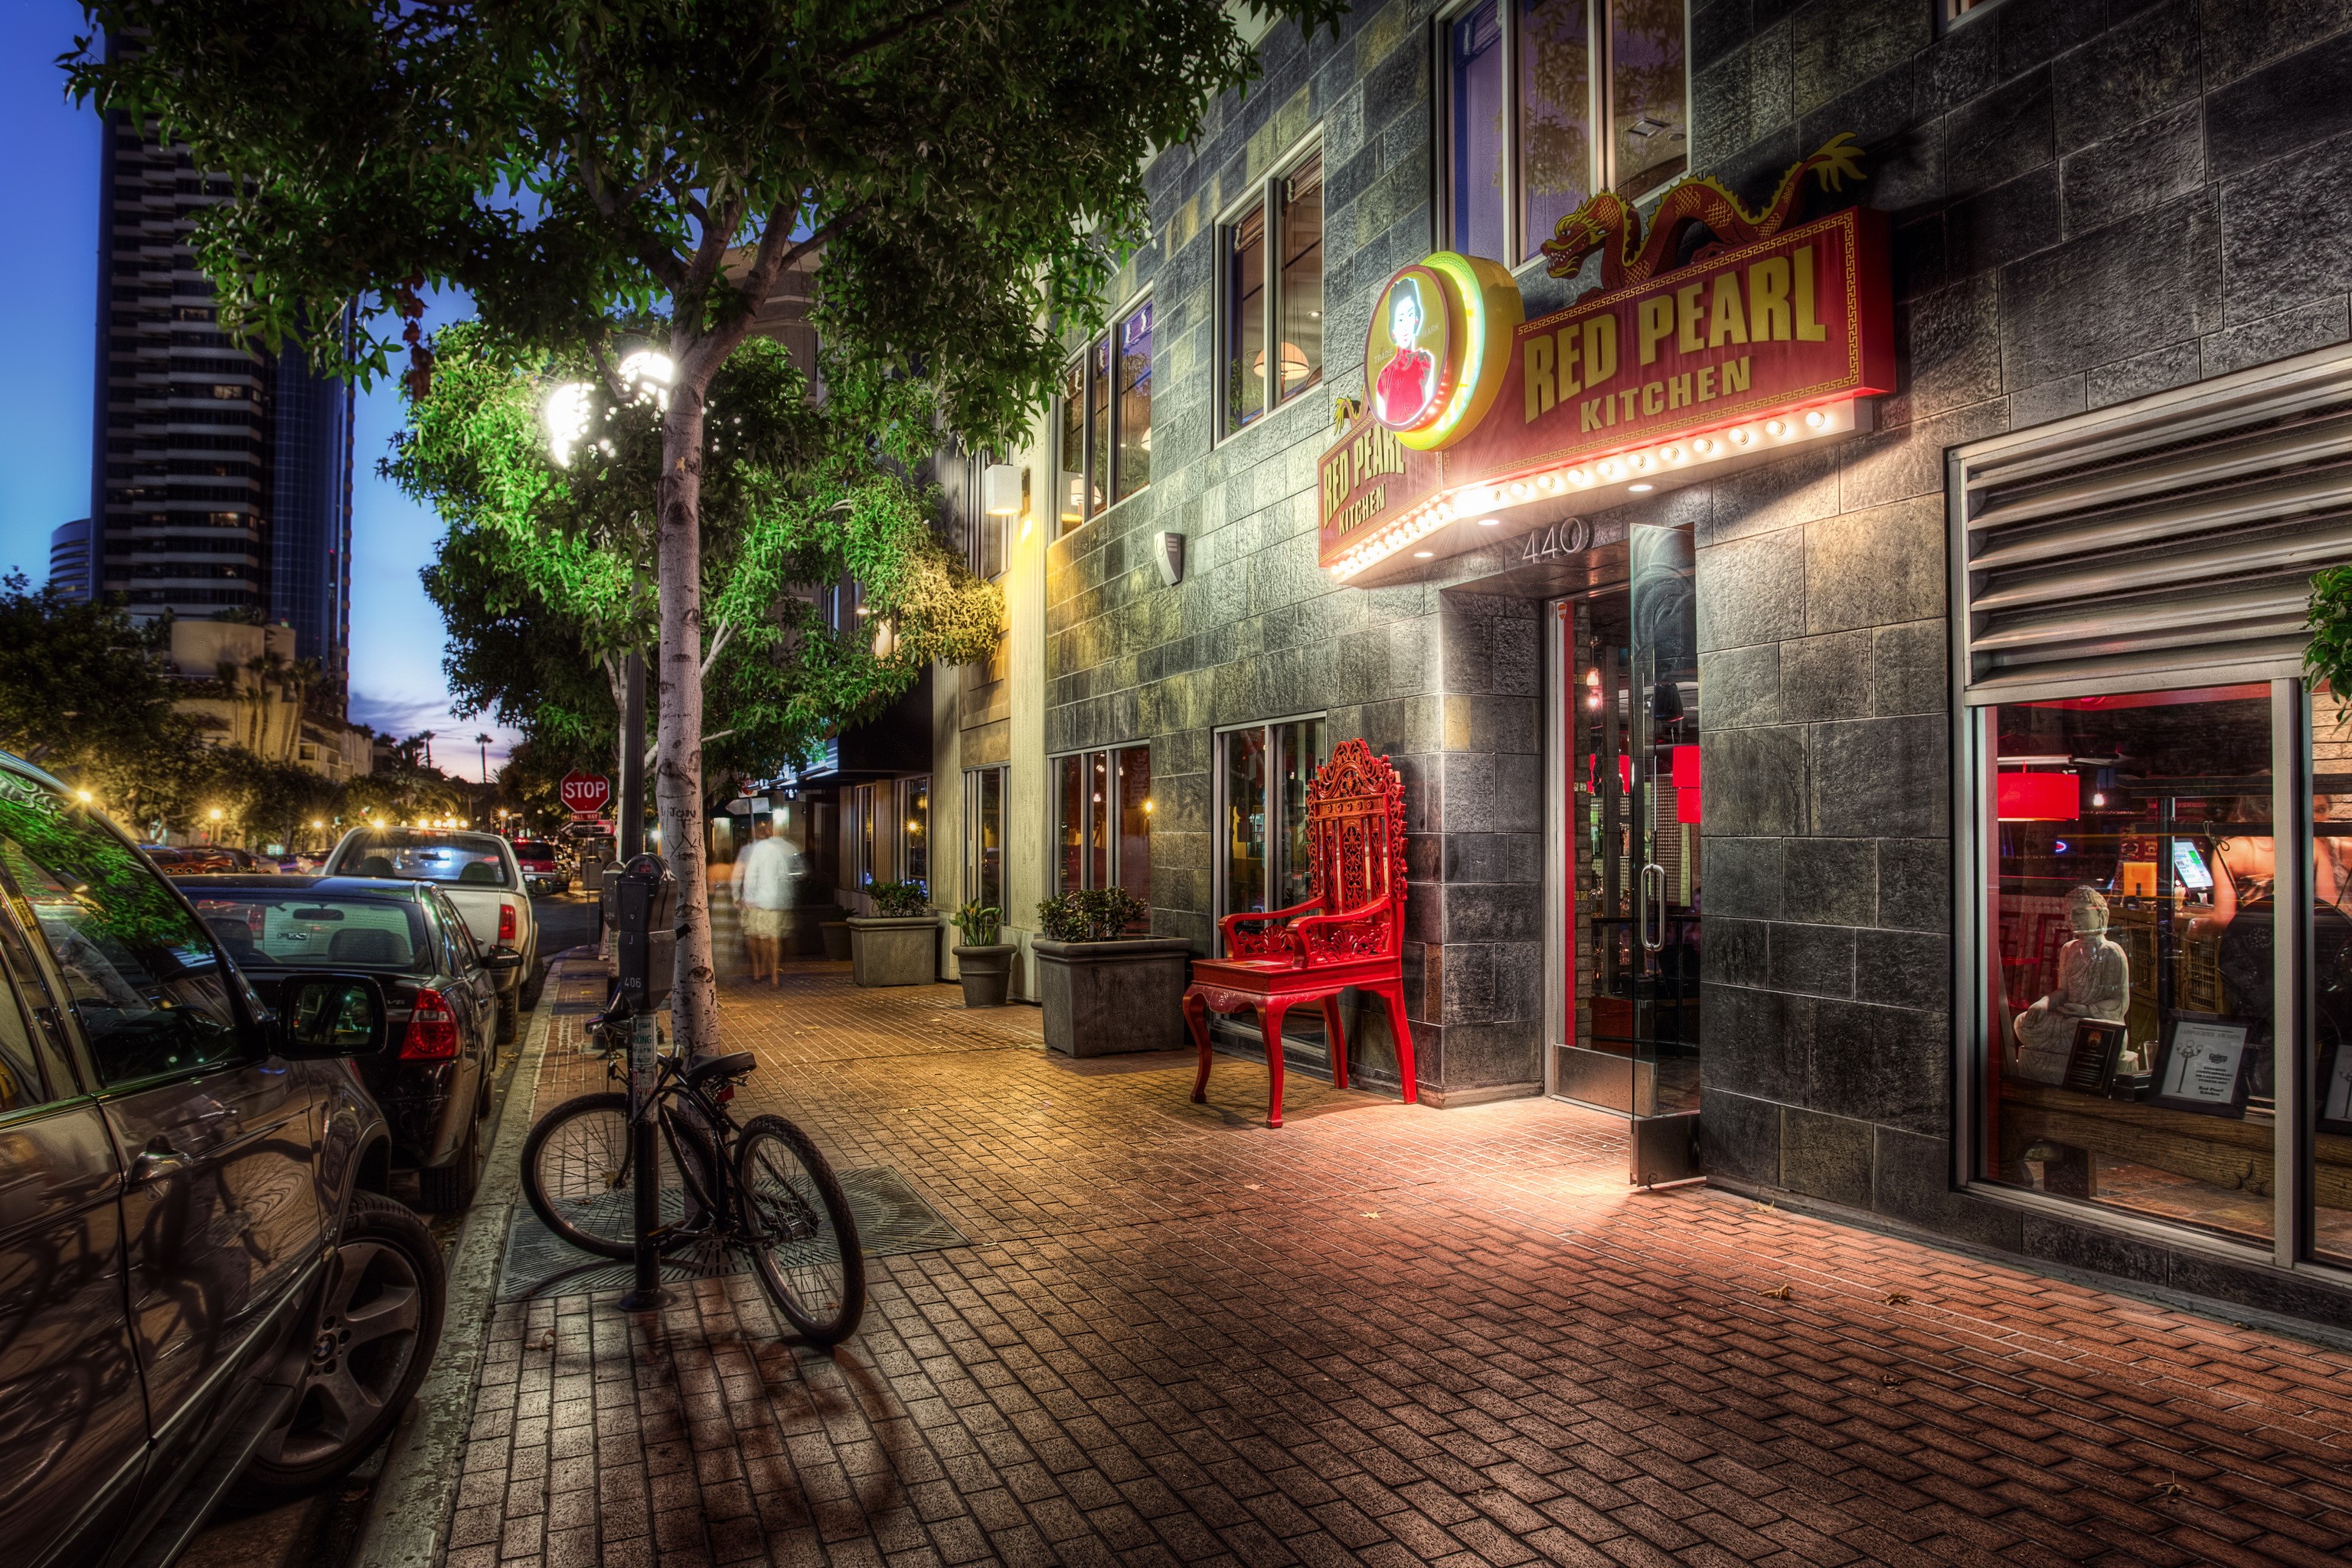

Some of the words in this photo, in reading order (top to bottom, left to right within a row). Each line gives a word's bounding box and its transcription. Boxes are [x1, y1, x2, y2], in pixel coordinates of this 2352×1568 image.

[1524, 314, 1617, 424] RED
[1638, 245, 1826, 366] PEARL
[1580, 356, 1752, 433] KITCHEN
[1323, 449, 1350, 529] RED
[1354, 423, 1406, 489] PEARL
[1338, 483, 1386, 537] KITCHEN
[1521, 517, 1587, 564] 440
[565, 782, 606, 799] STOP
[624, 977, 642, 988] 406
